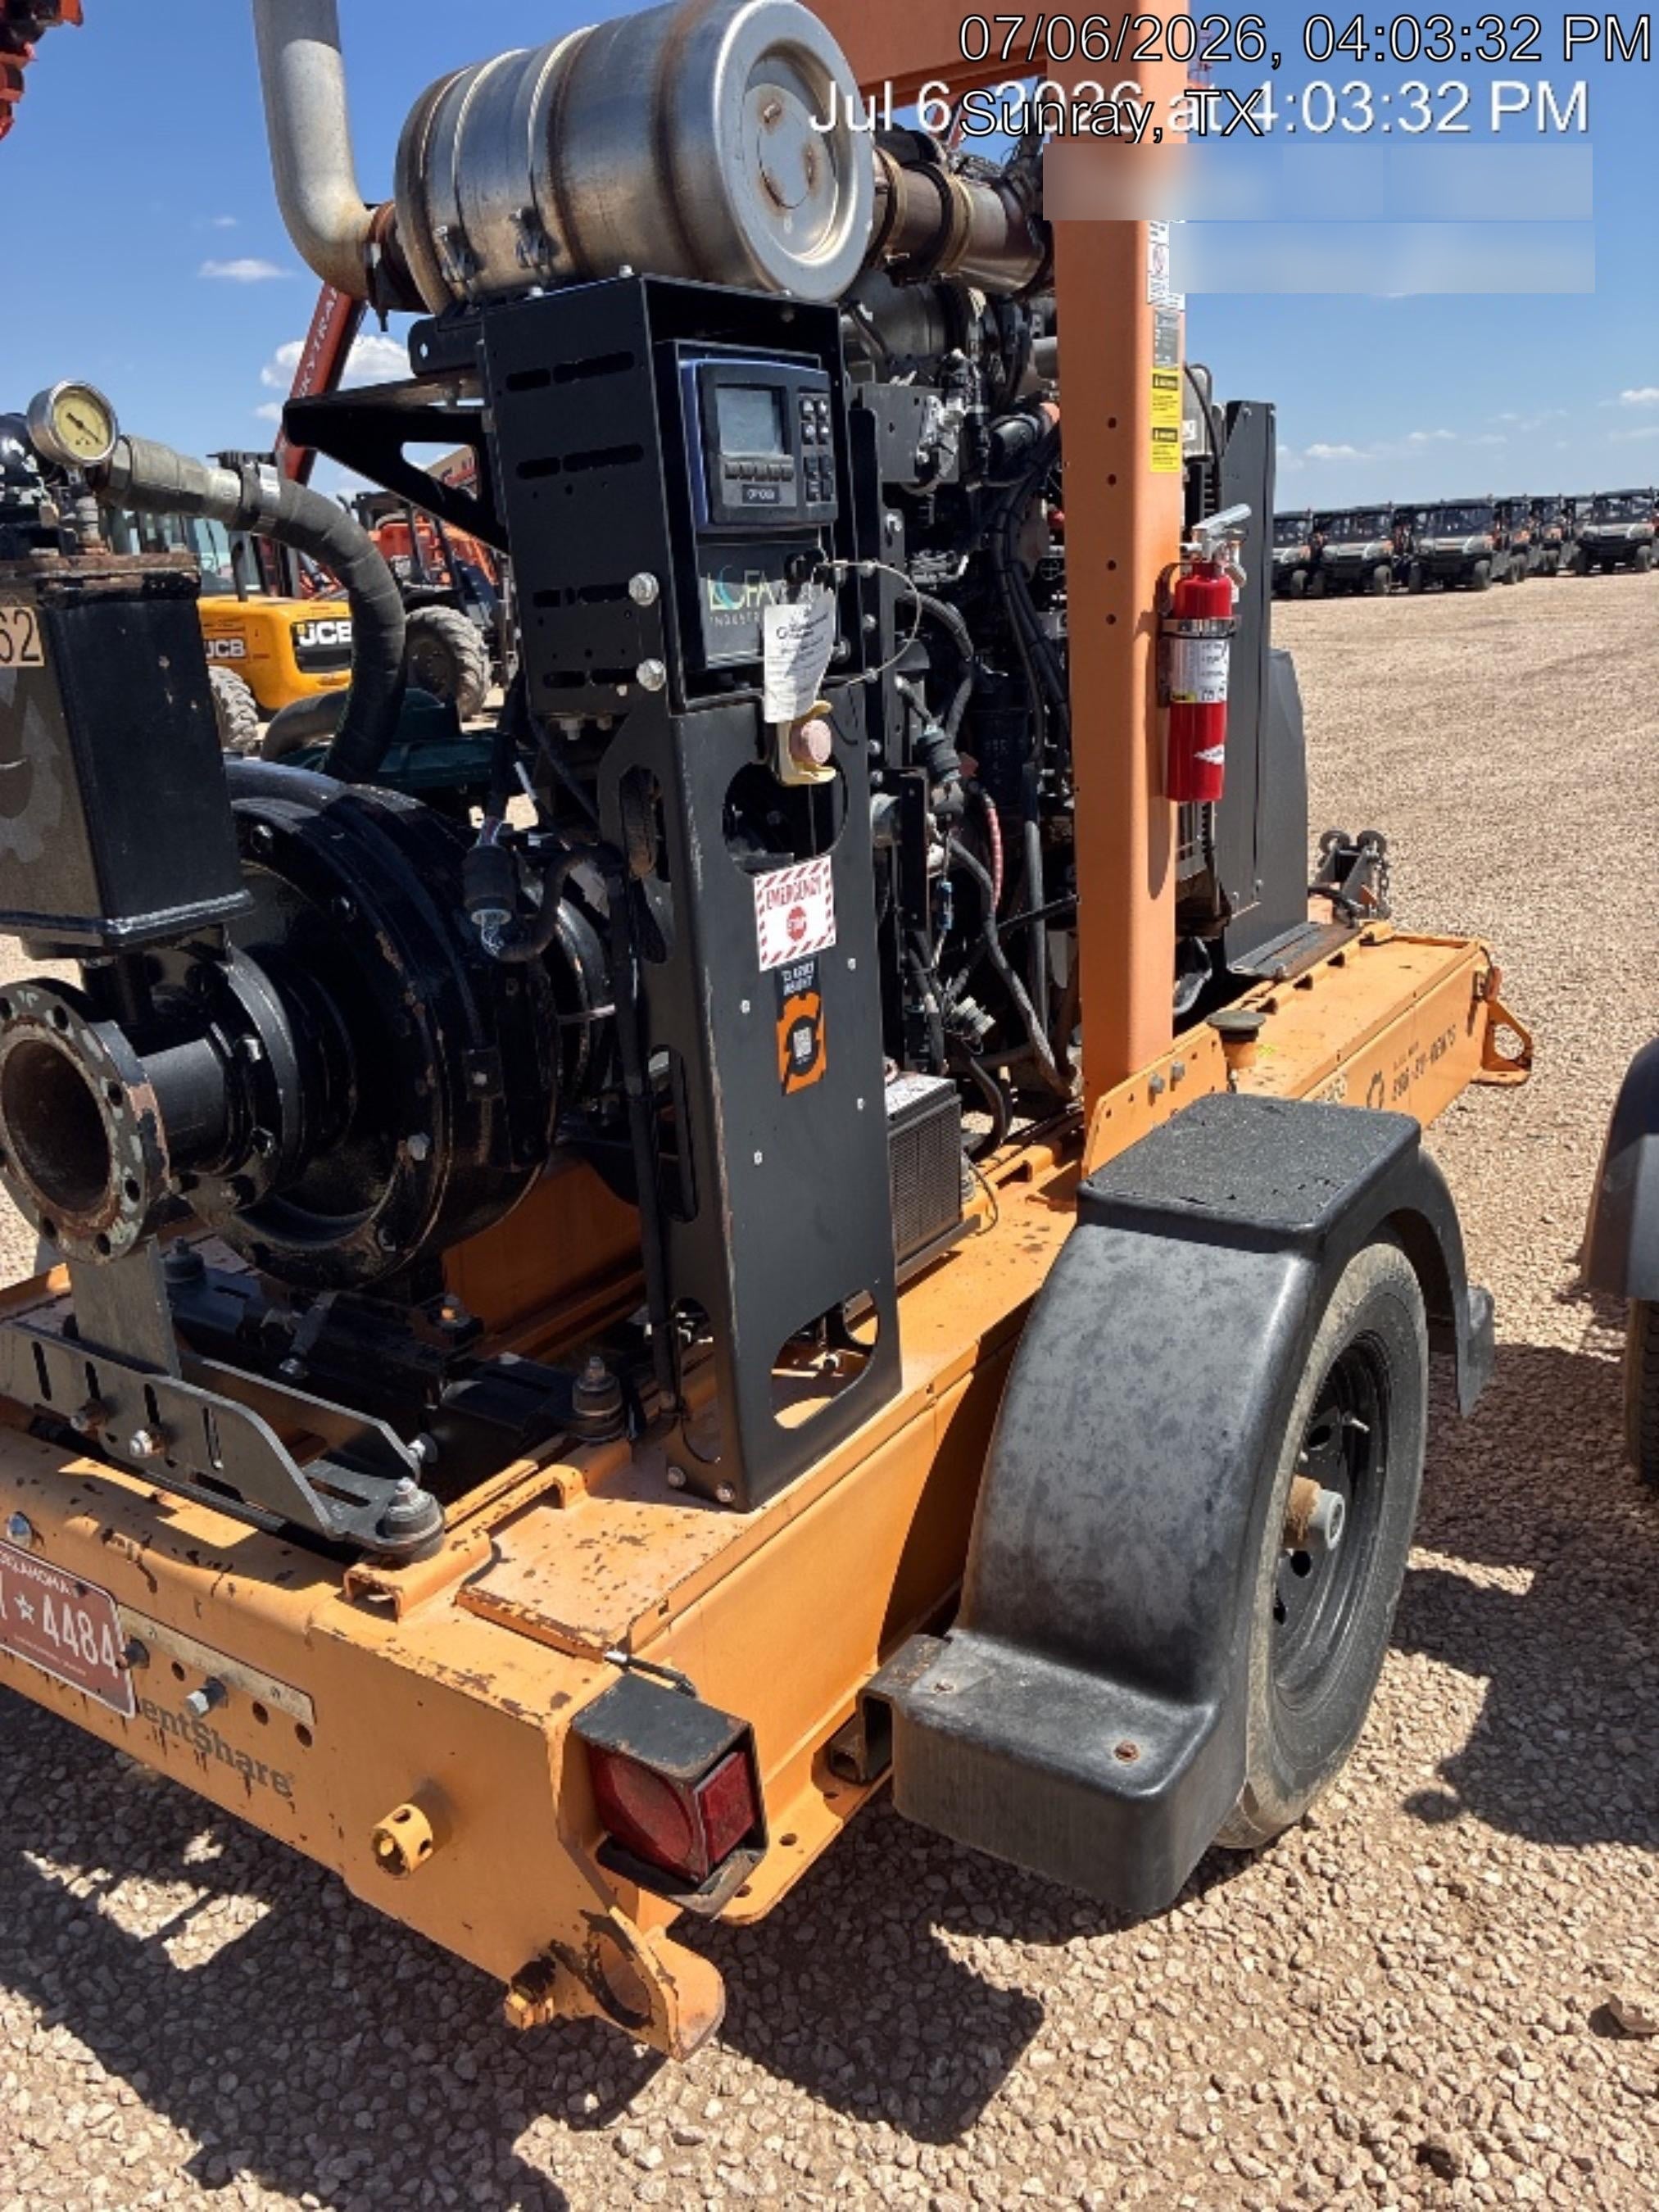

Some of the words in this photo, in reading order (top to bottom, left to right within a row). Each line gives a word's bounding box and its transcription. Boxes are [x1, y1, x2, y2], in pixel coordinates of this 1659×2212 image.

[205, 639, 245, 659] JCB
[297, 620, 352, 647] JCB
[43, 1593, 120, 1680] 4484
[140, 1697, 295, 1798] entShare
